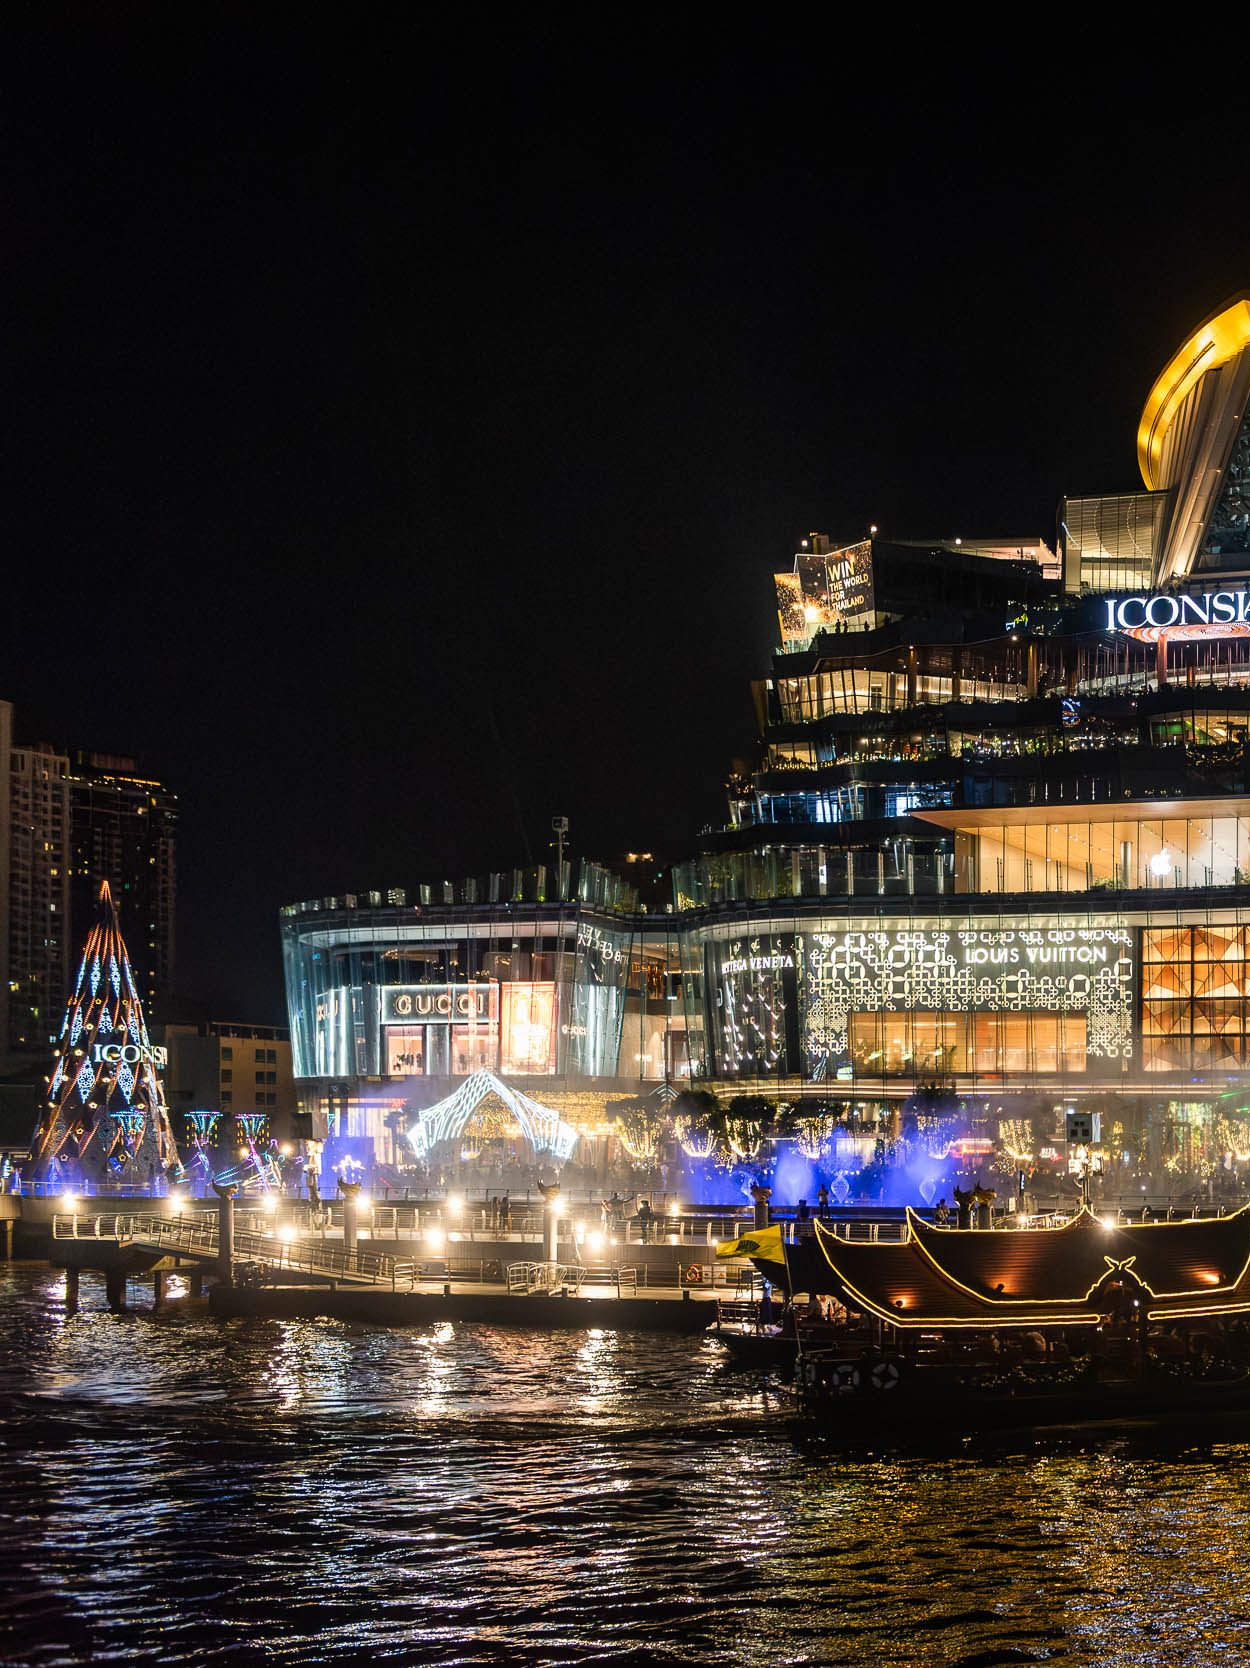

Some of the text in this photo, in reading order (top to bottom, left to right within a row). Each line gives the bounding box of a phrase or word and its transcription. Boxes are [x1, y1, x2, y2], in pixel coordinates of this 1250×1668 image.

[828, 560, 855, 581] WIN
[829, 573, 869, 592] THE WORLD
[830, 591, 845, 601] FOR
[832, 595, 865, 612] THAILAND
[749, 955, 794, 970] VENETA
[964, 946, 1107, 964] LOUIS VUITTON
[395, 994, 485, 1015] GUCCI
